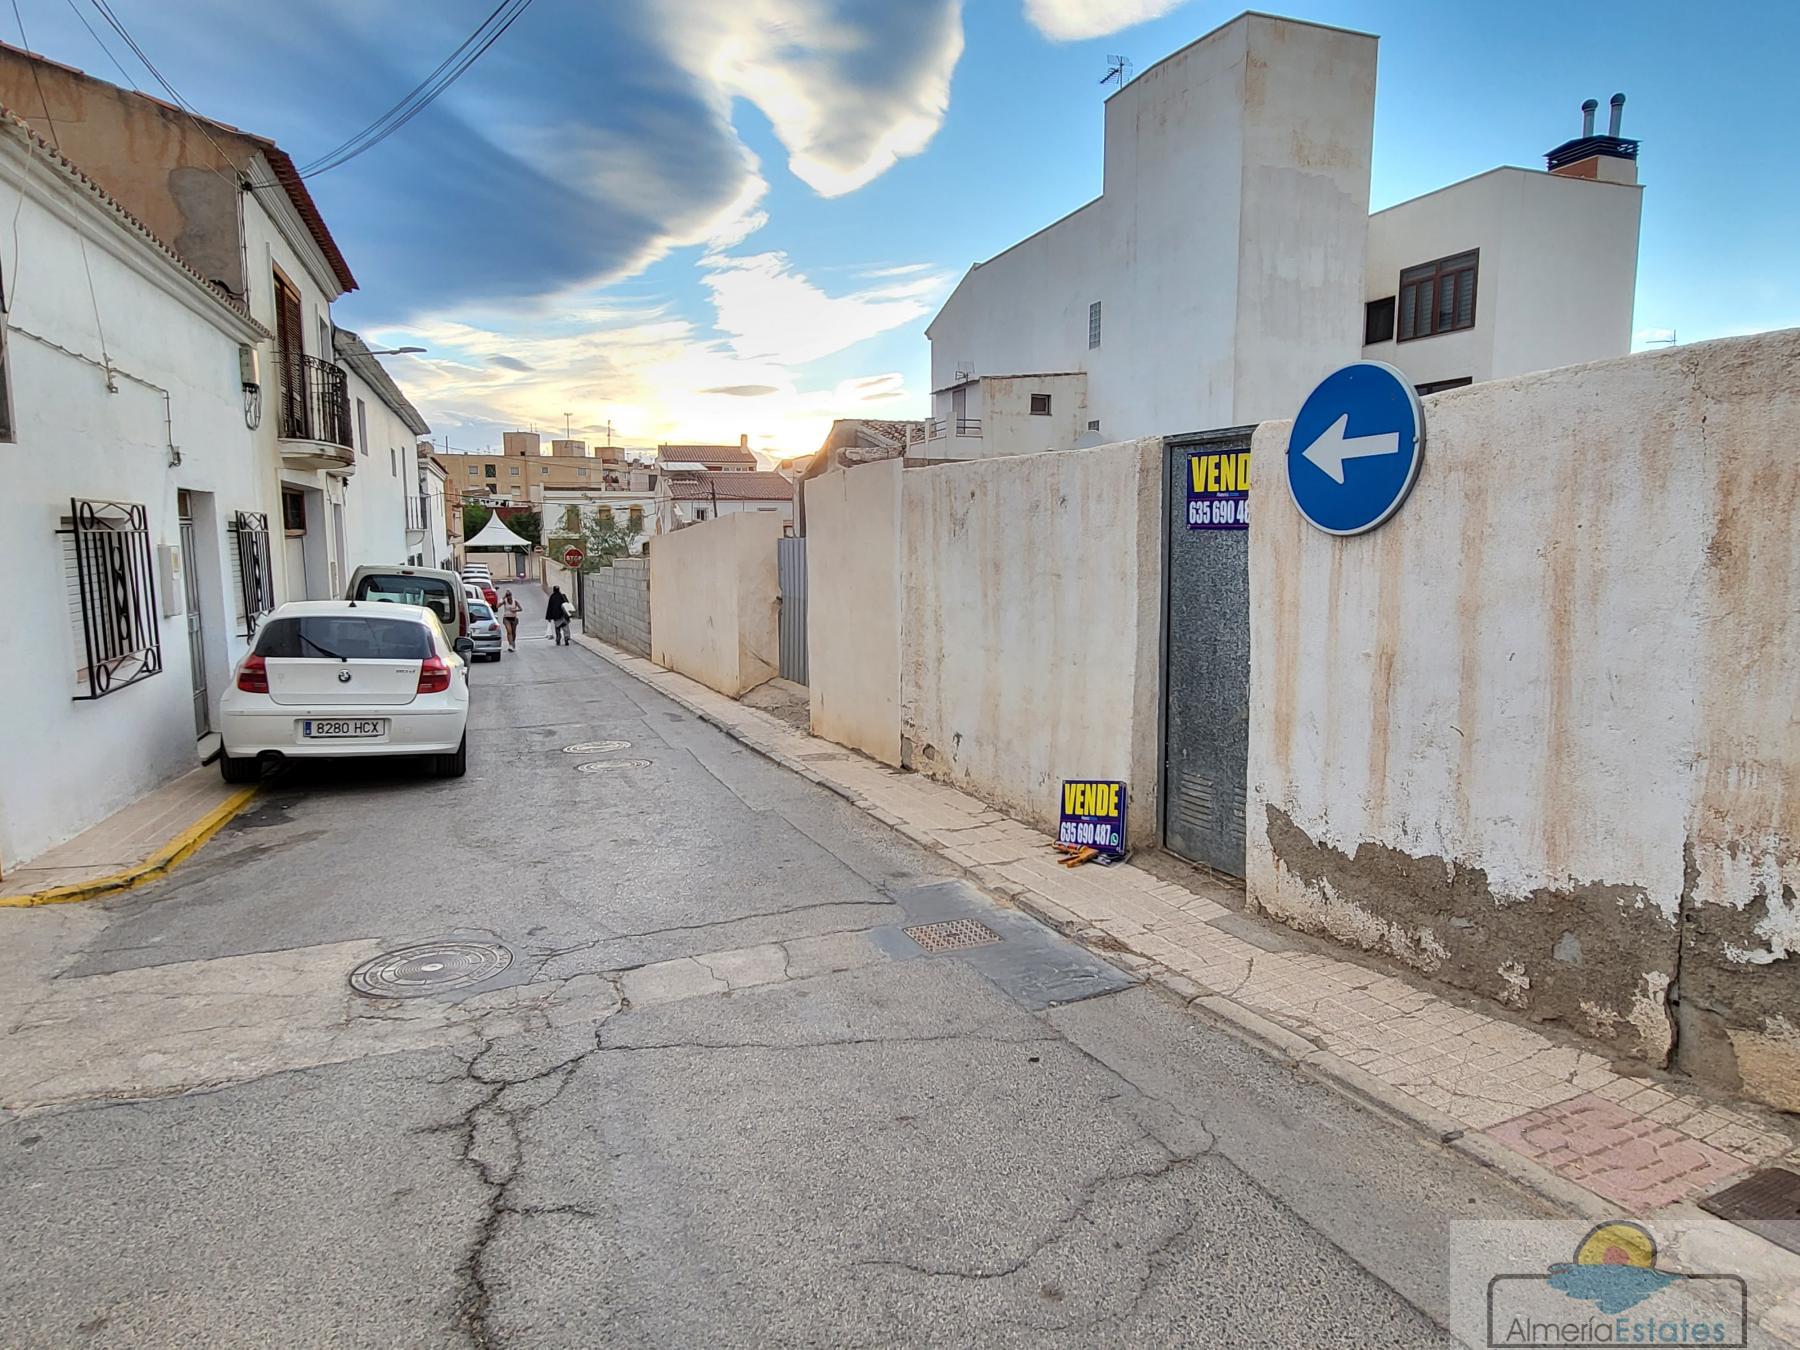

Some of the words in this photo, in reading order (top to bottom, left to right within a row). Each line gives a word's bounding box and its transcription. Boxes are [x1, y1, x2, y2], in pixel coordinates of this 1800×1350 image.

[1189, 501, 1211, 524] 635
[1212, 500, 1235, 524] 690
[316, 722, 350, 734] 8280
[354, 722, 379, 734] HCX
[1064, 783, 1119, 817] VENDE
[1060, 821, 1077, 842] 635
[1077, 822, 1094, 844] 690
[1095, 824, 1111, 846] 487
